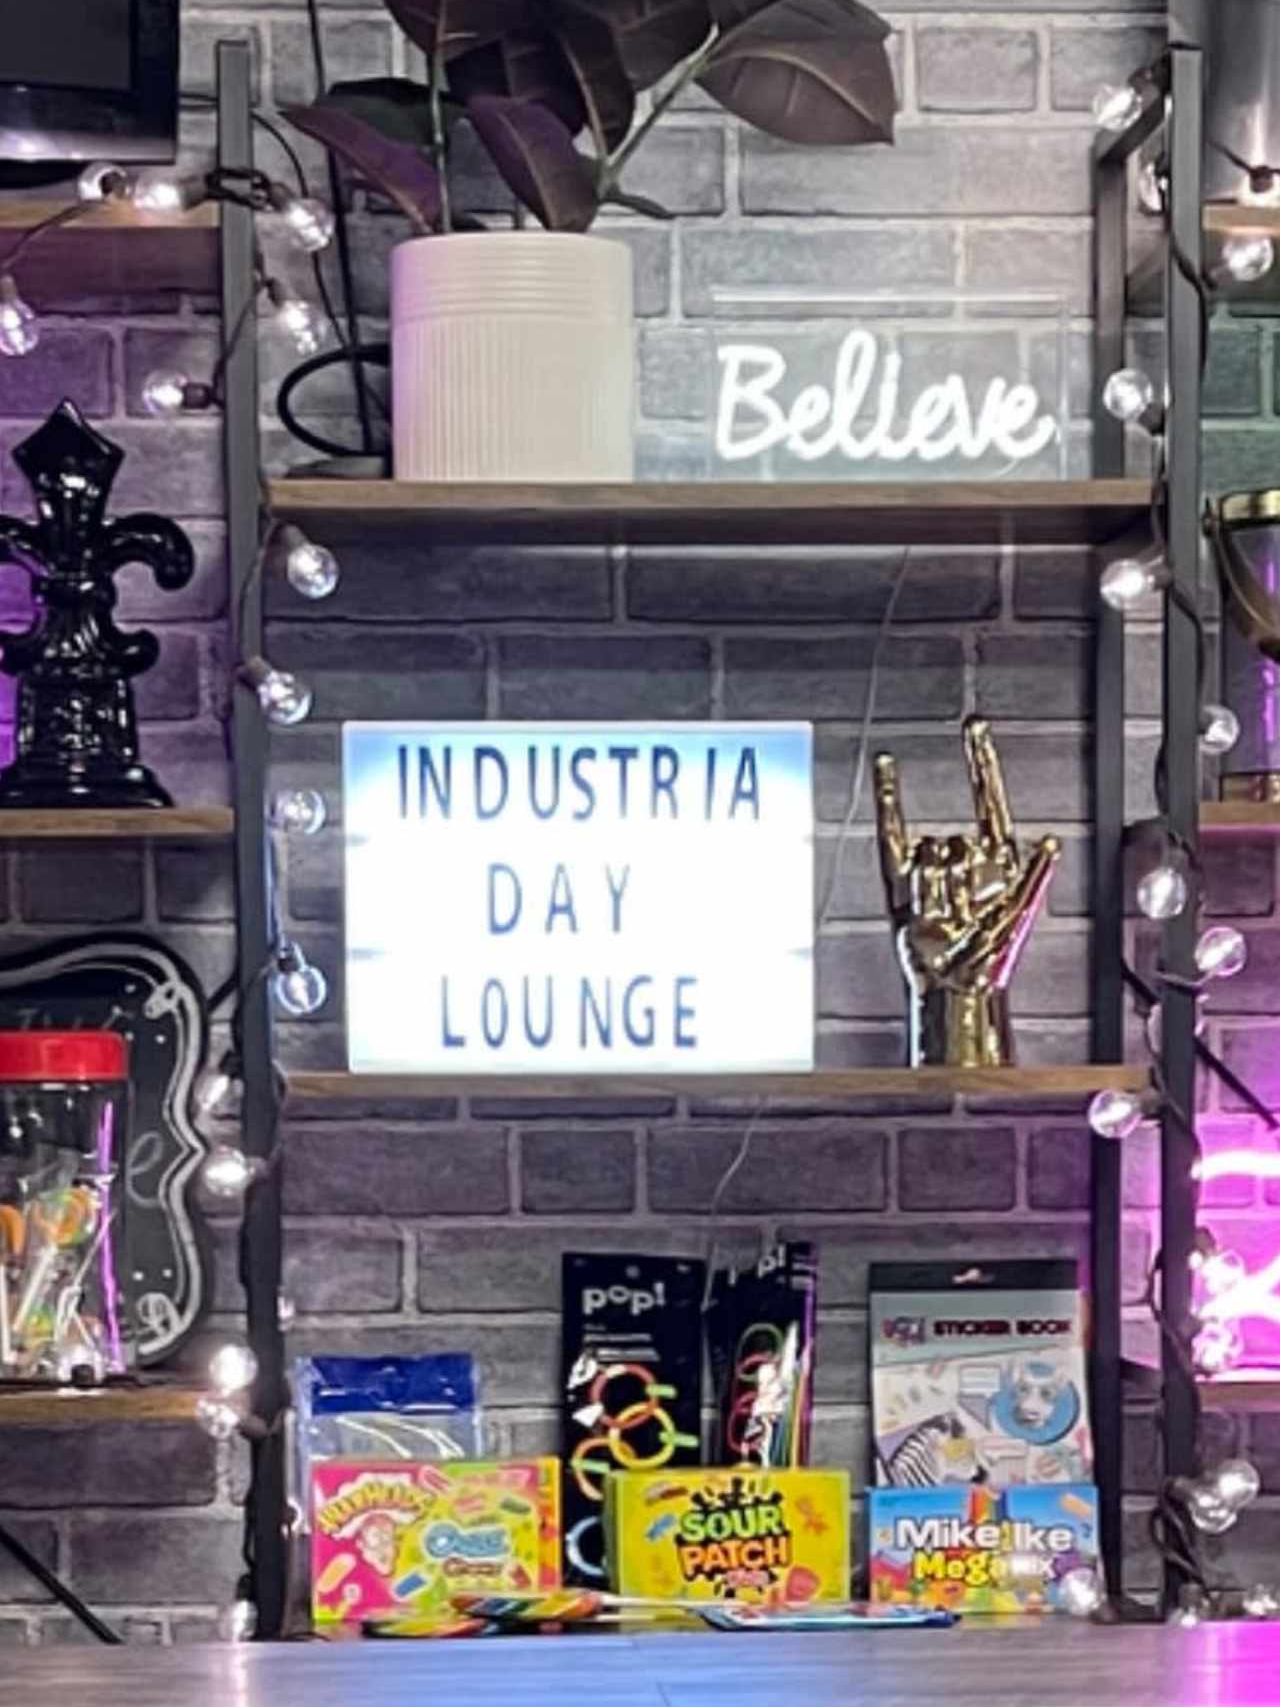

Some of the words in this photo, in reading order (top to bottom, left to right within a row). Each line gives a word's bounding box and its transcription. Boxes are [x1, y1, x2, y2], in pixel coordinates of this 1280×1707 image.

[715, 330, 1058, 461] Believe
[398, 744, 760, 821] INDUSTRIA
[488, 862, 631, 936] DAY
[442, 975, 699, 1049] LOUNGE
[582, 1281, 666, 1316] pop!
[681, 1506, 783, 1542] SOUR
[895, 1517, 1000, 1550] Mike
[1012, 1520, 1073, 1551] Ike
[682, 1537, 789, 1577] PATCH
[913, 1549, 1008, 1588] Mega
